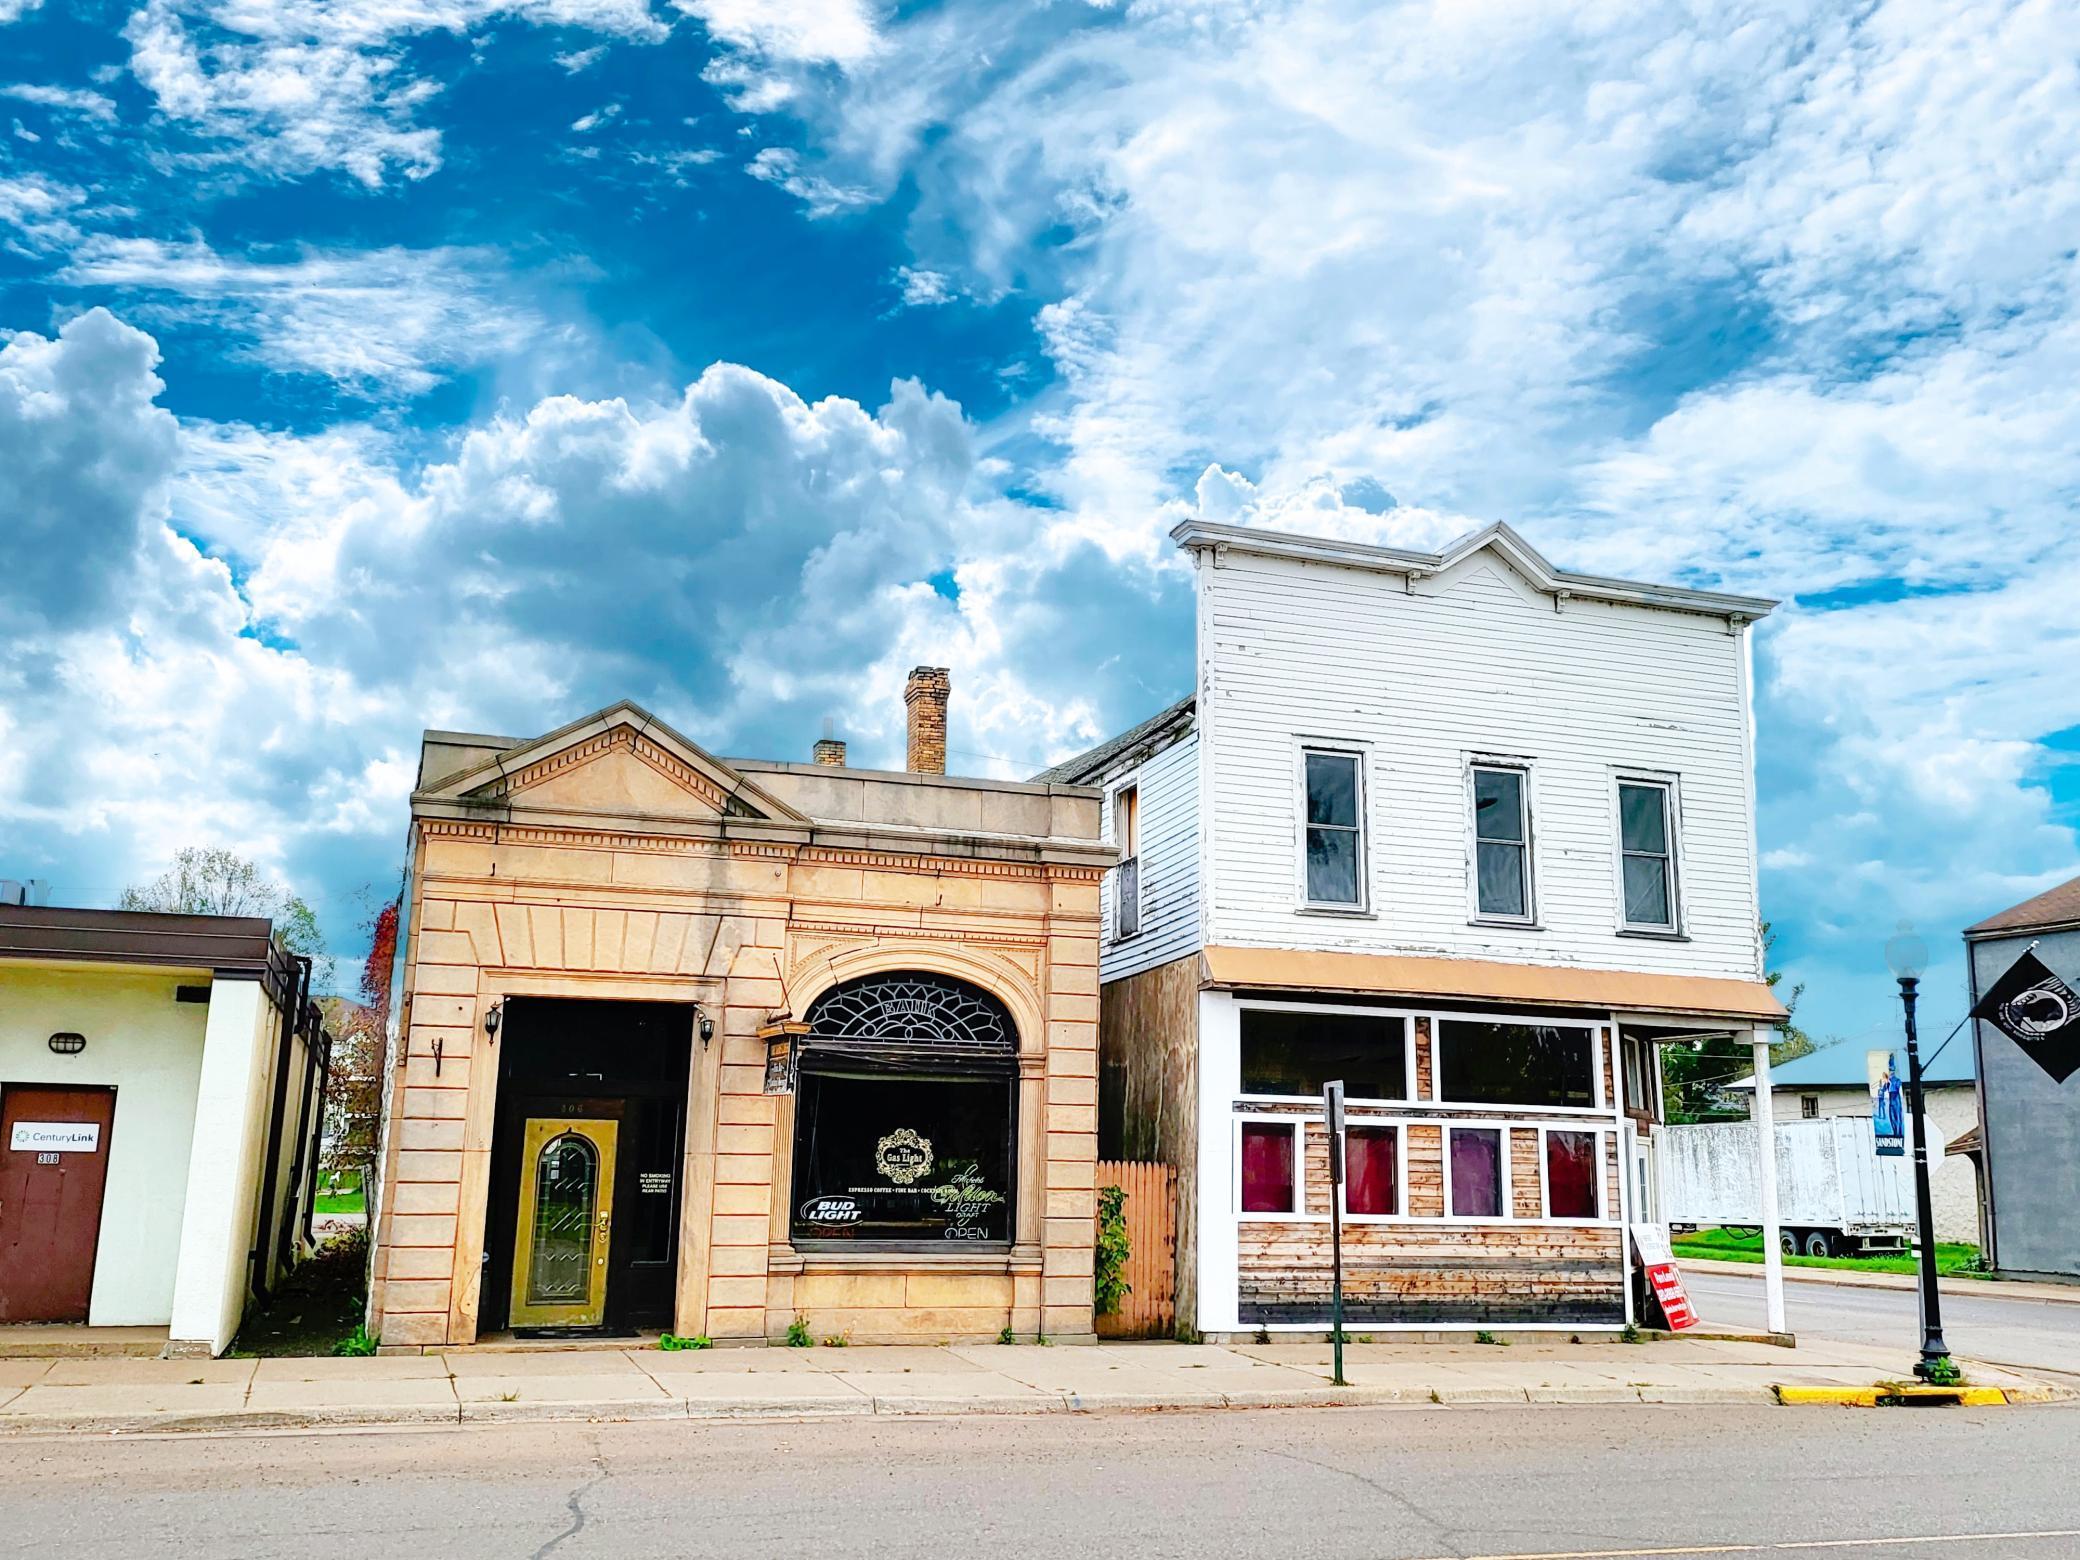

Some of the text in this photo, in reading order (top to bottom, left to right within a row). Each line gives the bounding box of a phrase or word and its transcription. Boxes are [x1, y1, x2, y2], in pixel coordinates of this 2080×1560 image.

[881, 1000, 935, 1017] BANK
[32, 1132, 94, 1143] CenturyLink
[1875, 1137, 1903, 1148] SANDSTONE
[39, 1154, 58, 1163] 308
[887, 1154, 922, 1166] Gas Light
[817, 1201, 855, 1211] BUD
[944, 1203, 991, 1213] LIGHT
[808, 1210, 862, 1220] LIGHT
[944, 1227, 989, 1239] OPEN
